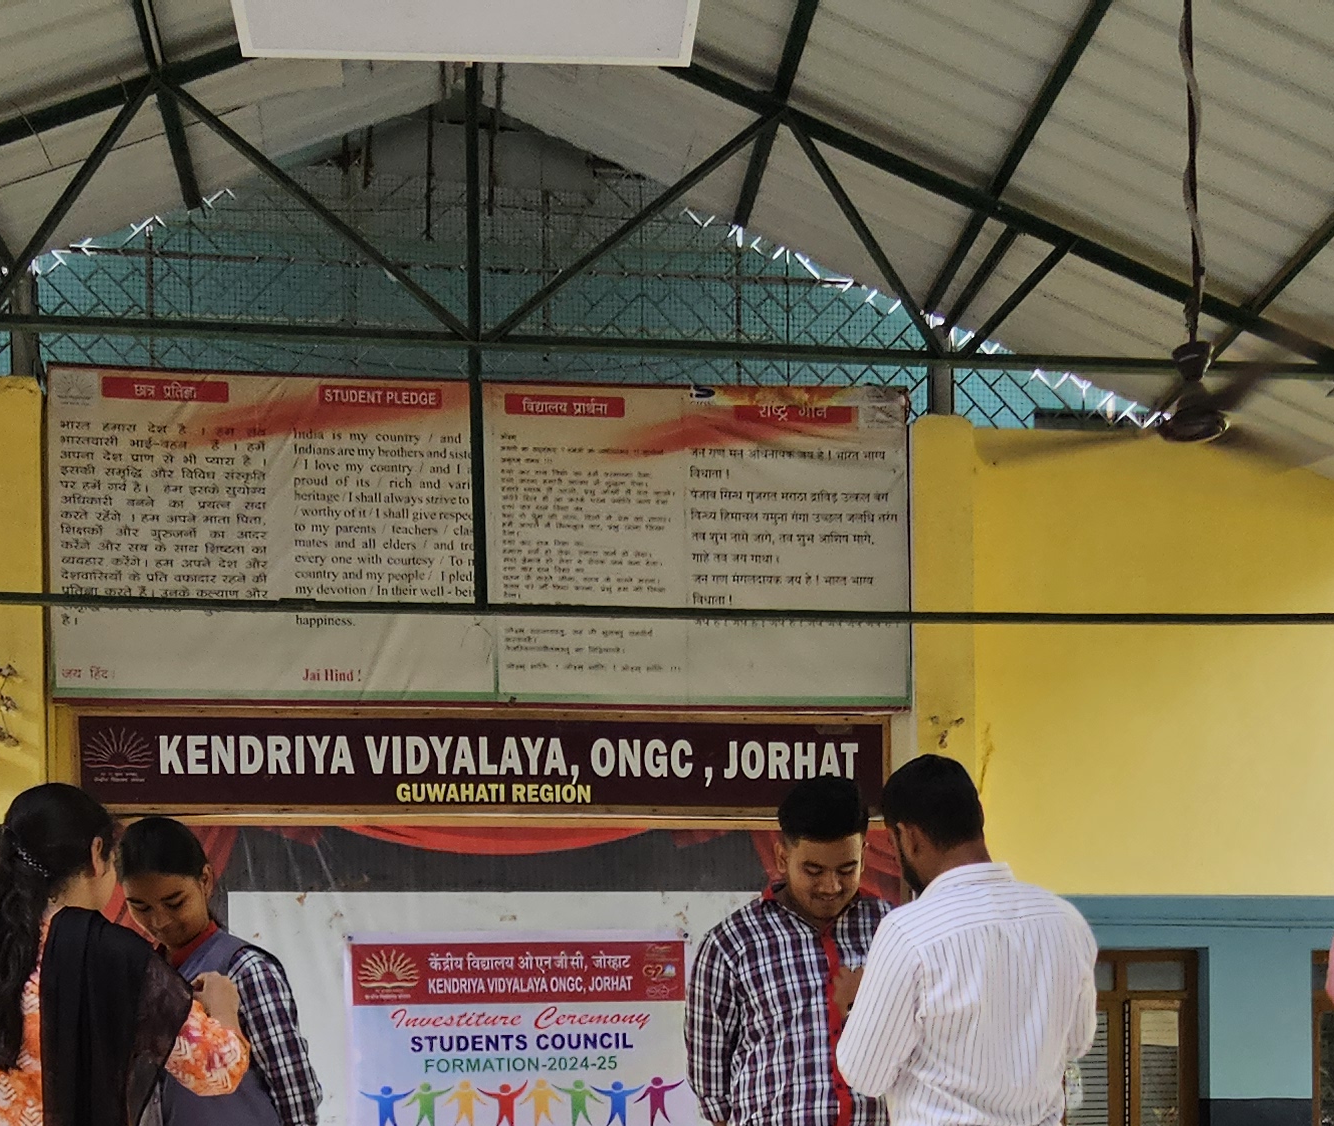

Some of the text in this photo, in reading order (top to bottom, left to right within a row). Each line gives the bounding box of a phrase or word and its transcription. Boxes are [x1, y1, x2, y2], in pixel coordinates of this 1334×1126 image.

[134, 383, 156, 397] छात्र
[324, 389, 438, 406] STUDENT PLEDGE
[522, 397, 608, 415] विद्यालय प्रार्थना
[293, 427, 462, 445] India is my country and
[293, 444, 447, 460] Indians are my brothers and
[315, 459, 339, 471] love
[346, 463, 363, 473] my
[370, 462, 413, 475] country
[429, 463, 450, 474] and
[293, 475, 472, 490] proud of its rich and vari
[294, 490, 339, 503] heritage
[355, 492, 382, 503] shall
[384, 493, 423, 506] always
[425, 495, 457, 505] strive
[458, 495, 469, 505] to
[301, 507, 341, 519] worthy
[344, 507, 357, 518] of
[358, 508, 367, 518] it
[383, 508, 409, 519] shall
[412, 510, 436, 522] give
[439, 512, 473, 523] respec
[294, 523, 438, 536] to my parents teachers
[294, 538, 454, 551] mates and all elders and
[294, 554, 463, 567] every one with courtesy To
[294, 569, 338, 581] country
[342, 569, 363, 580] and
[366, 571, 384, 582] my
[387, 570, 425, 583] people
[449, 571, 473, 583] pled
[295, 584, 444, 597] my devotion In their well
[295, 615, 356, 628] happiness.
[61, 668, 81, 679] जय
[302, 668, 354, 682] Jai Hind
[159, 735, 355, 775] KENDRIYA
[364, 735, 580, 784] VIDYALAYA,
[590, 738, 694, 779] ONGC
[723, 740, 859, 780] JORHAT
[396, 783, 592, 804] GUWAHATI REGION
[428, 953, 464, 971] केंद्रीय
[466, 952, 515, 971] विद्यालय
[591, 951, 631, 972] जोरहाट
[428, 978, 486, 994] KENDRIYA
[488, 977, 548, 994] VIDYALAYA
[550, 976, 587, 995] ONGC,
[588, 976, 633, 993] JORHAT
[390, 1006, 651, 1030] Investiture Ceremony
[410, 1032, 634, 1053] STUDENTS COUNCIL
[424, 1056, 618, 1073] FORMATION-2024-25
